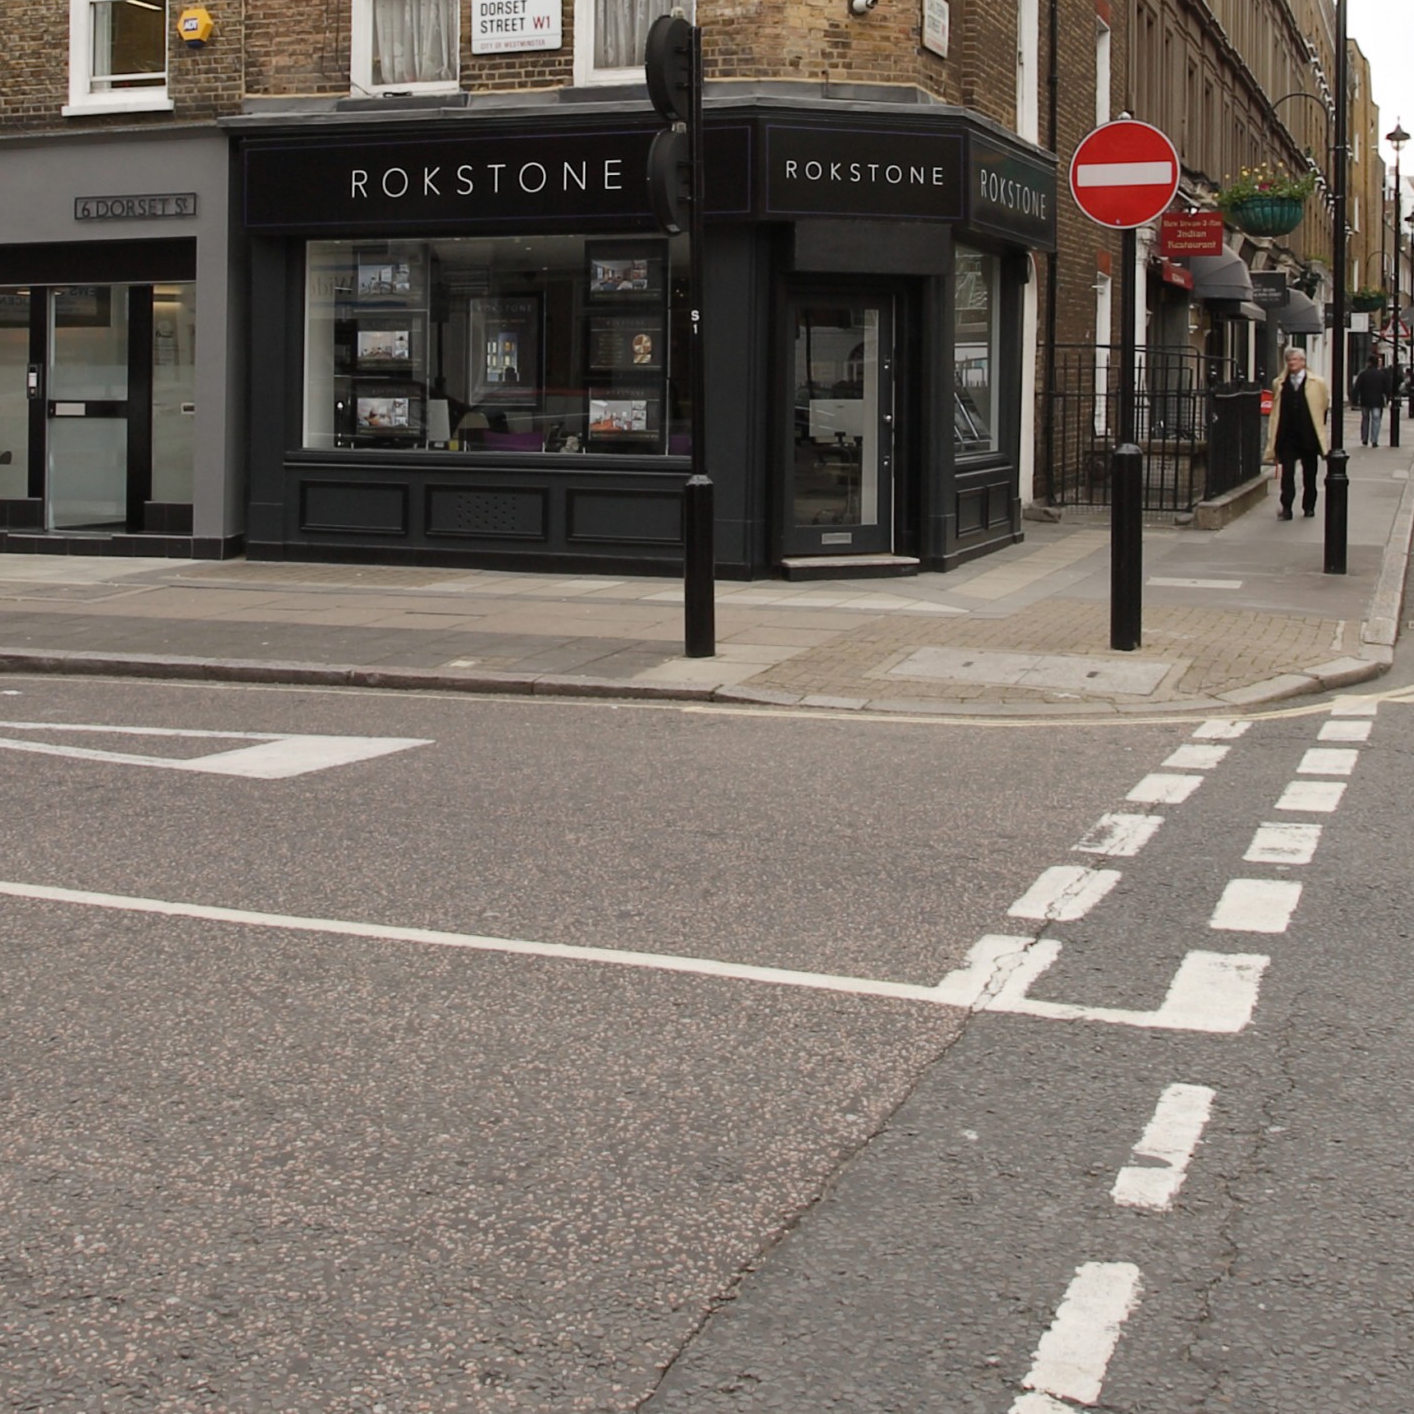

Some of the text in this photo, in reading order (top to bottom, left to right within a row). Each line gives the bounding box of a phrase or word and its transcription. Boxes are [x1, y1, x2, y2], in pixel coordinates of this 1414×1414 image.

[480, 0, 528, 16] DORSET
[480, 15, 551, 34] STREET W1
[480, 39, 546, 50] CITY OF WESTMINSTER
[351, 159, 623, 198] ROKSTONE
[785, 160, 944, 185] ROKSTONE
[980, 168, 1047, 221] ROKSTONE
[82, 201, 91, 218] 6
[96, 197, 170, 218] DORSET
[1176, 230, 1207, 239] Indian
[1167, 241, 1217, 250] Restaurant
[690, 310, 701, 321] S
[692, 324, 699, 334] 1
